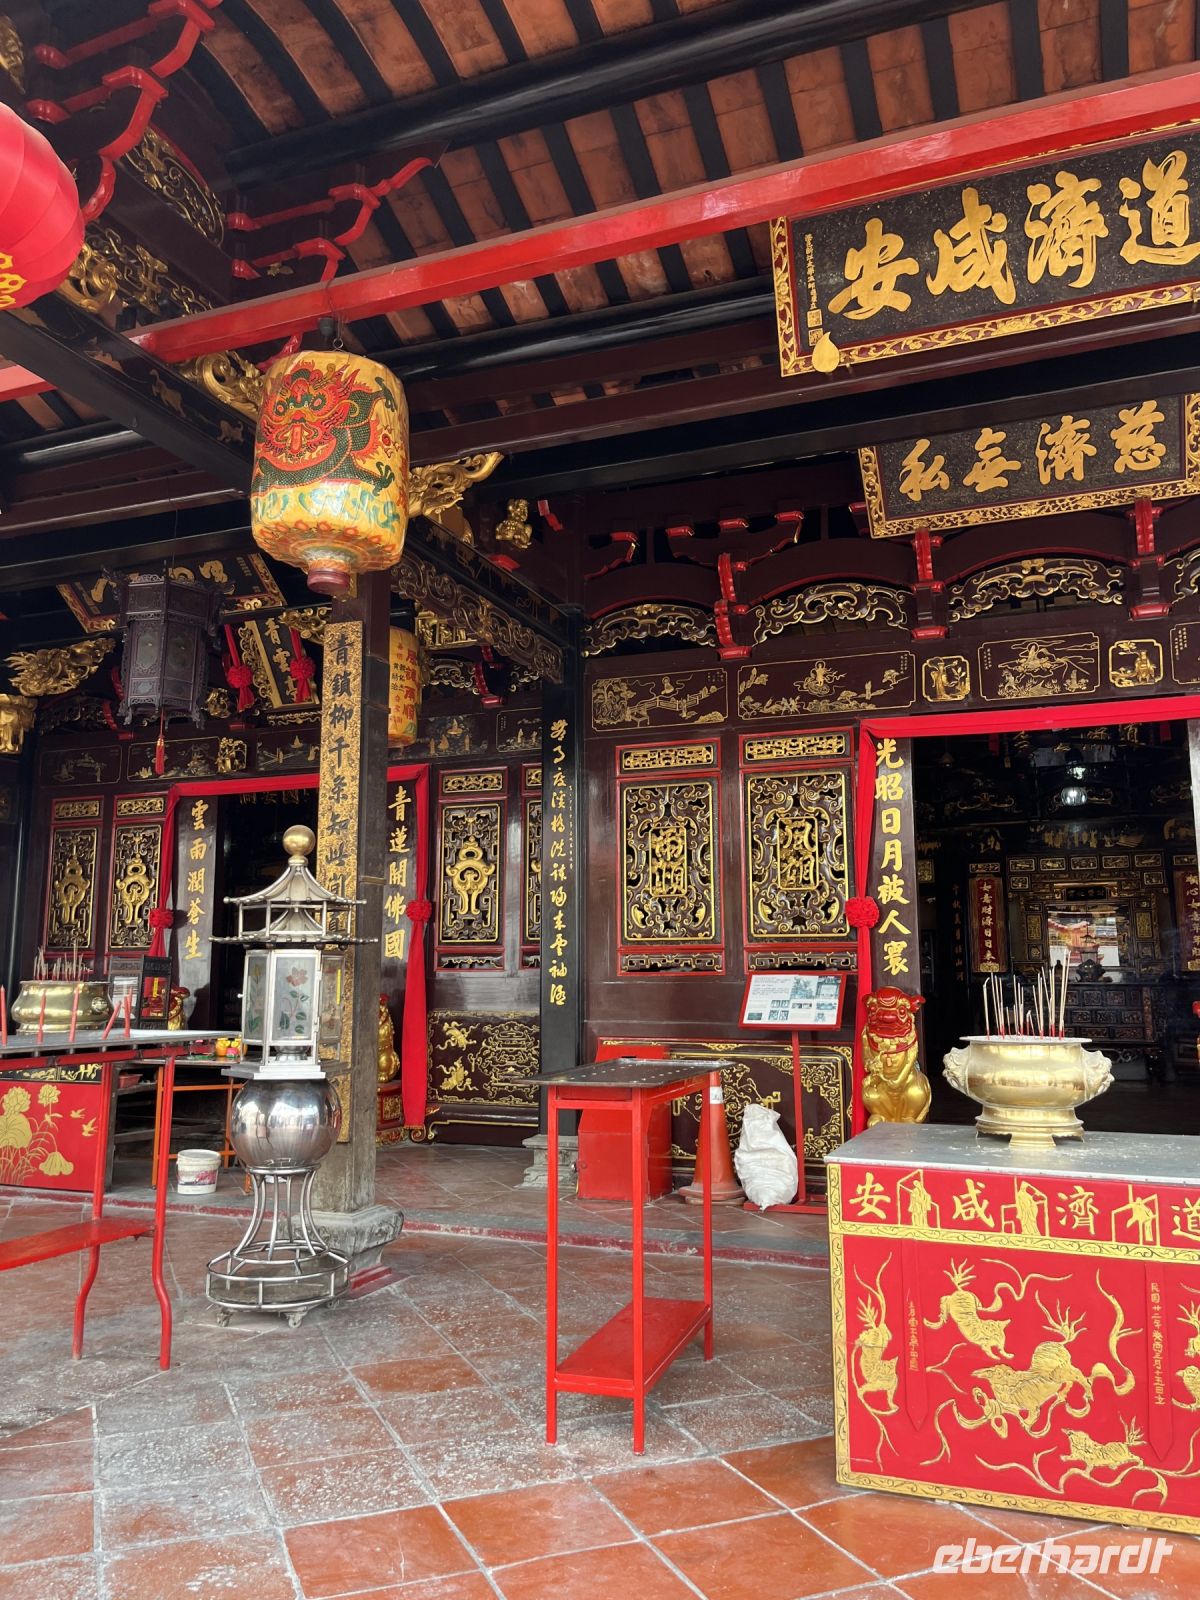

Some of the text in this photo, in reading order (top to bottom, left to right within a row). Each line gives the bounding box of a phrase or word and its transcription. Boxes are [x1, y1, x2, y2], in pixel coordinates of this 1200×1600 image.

[184, 799, 209, 960] 雲雨潤蒼生
[384, 785, 412, 960] 青蓮開佛國
[875, 738, 911, 976] 光昭日月被人寰
